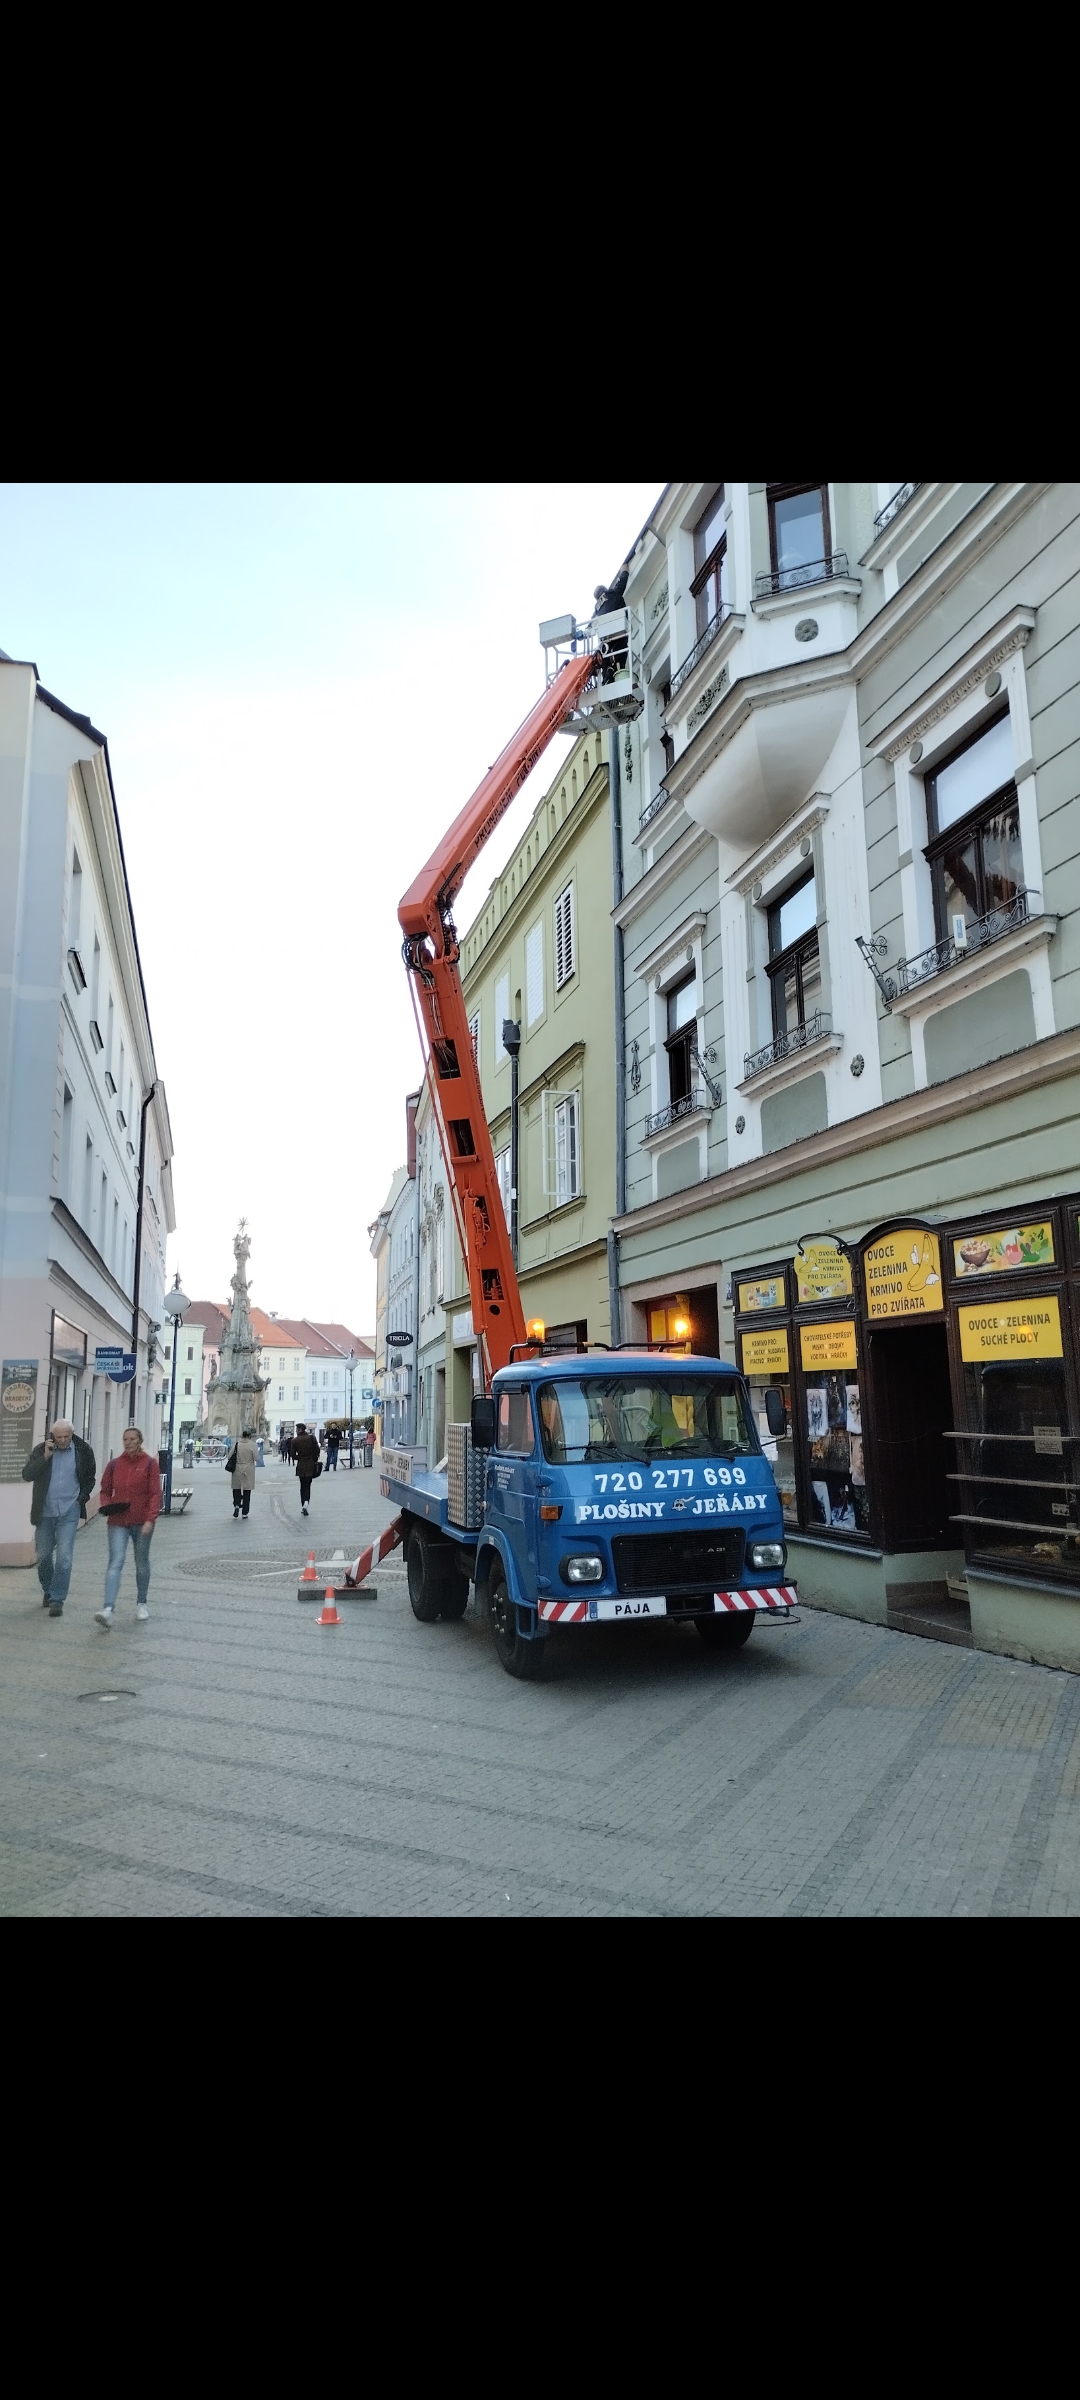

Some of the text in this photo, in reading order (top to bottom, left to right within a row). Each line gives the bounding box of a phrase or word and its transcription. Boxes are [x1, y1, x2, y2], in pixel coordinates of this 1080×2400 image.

[867, 1245, 895, 1261] OVOCE
[868, 1261, 908, 1279] ZELENINA
[870, 1281, 903, 1297] KRMIVO
[871, 1296, 925, 1315] PRO ZVÍŘATA
[968, 1313, 1051, 1331] OVOCE ZELENINA
[981, 1332, 1039, 1346] SUCHÉ PLODY
[594, 1467, 746, 1493] 720 277 699
[579, 1493, 768, 1521] PLOŠINY JEŘÁBY
[614, 1602, 650, 1615] PÁJA
